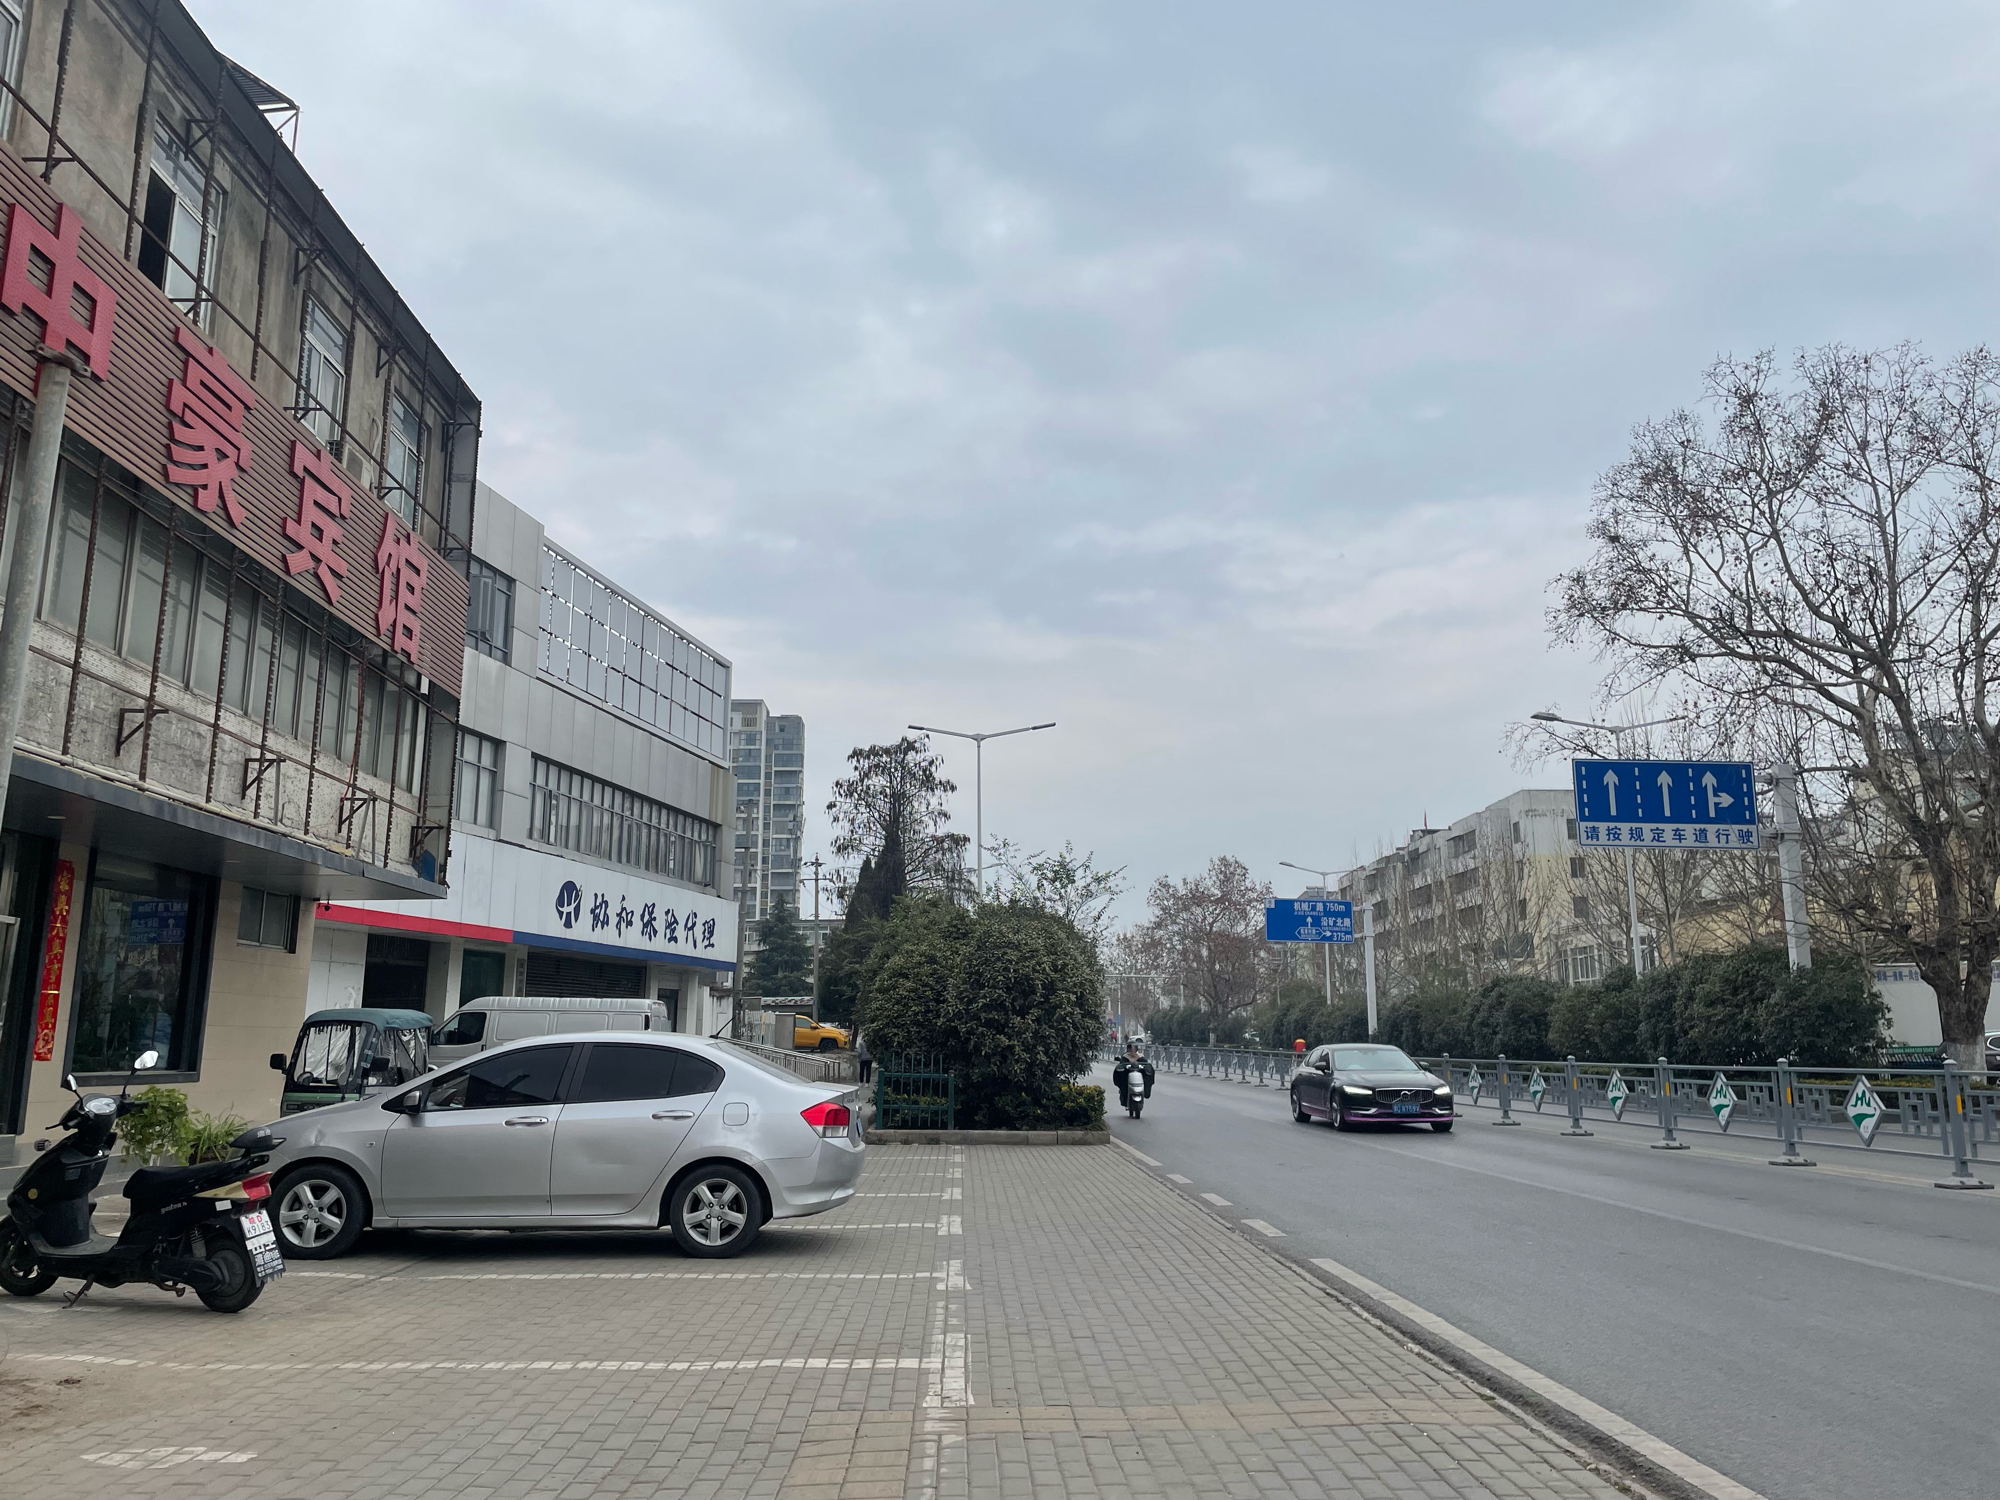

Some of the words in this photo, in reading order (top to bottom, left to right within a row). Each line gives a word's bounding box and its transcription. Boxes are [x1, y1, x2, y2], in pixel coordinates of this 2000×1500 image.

[0, 203, 428, 663] 中豪宾馆
[1584, 825, 1754, 845] 请按规定车道行驶
[1294, 902, 1324, 911] 机械厂路
[1326, 903, 1345, 912] 750m
[590, 893, 716, 950] 协和保险代理
[1321, 917, 1351, 927] 沿矿北路
[1332, 933, 1352, 942] 375m
[246, 1221, 271, 1237] K9183
